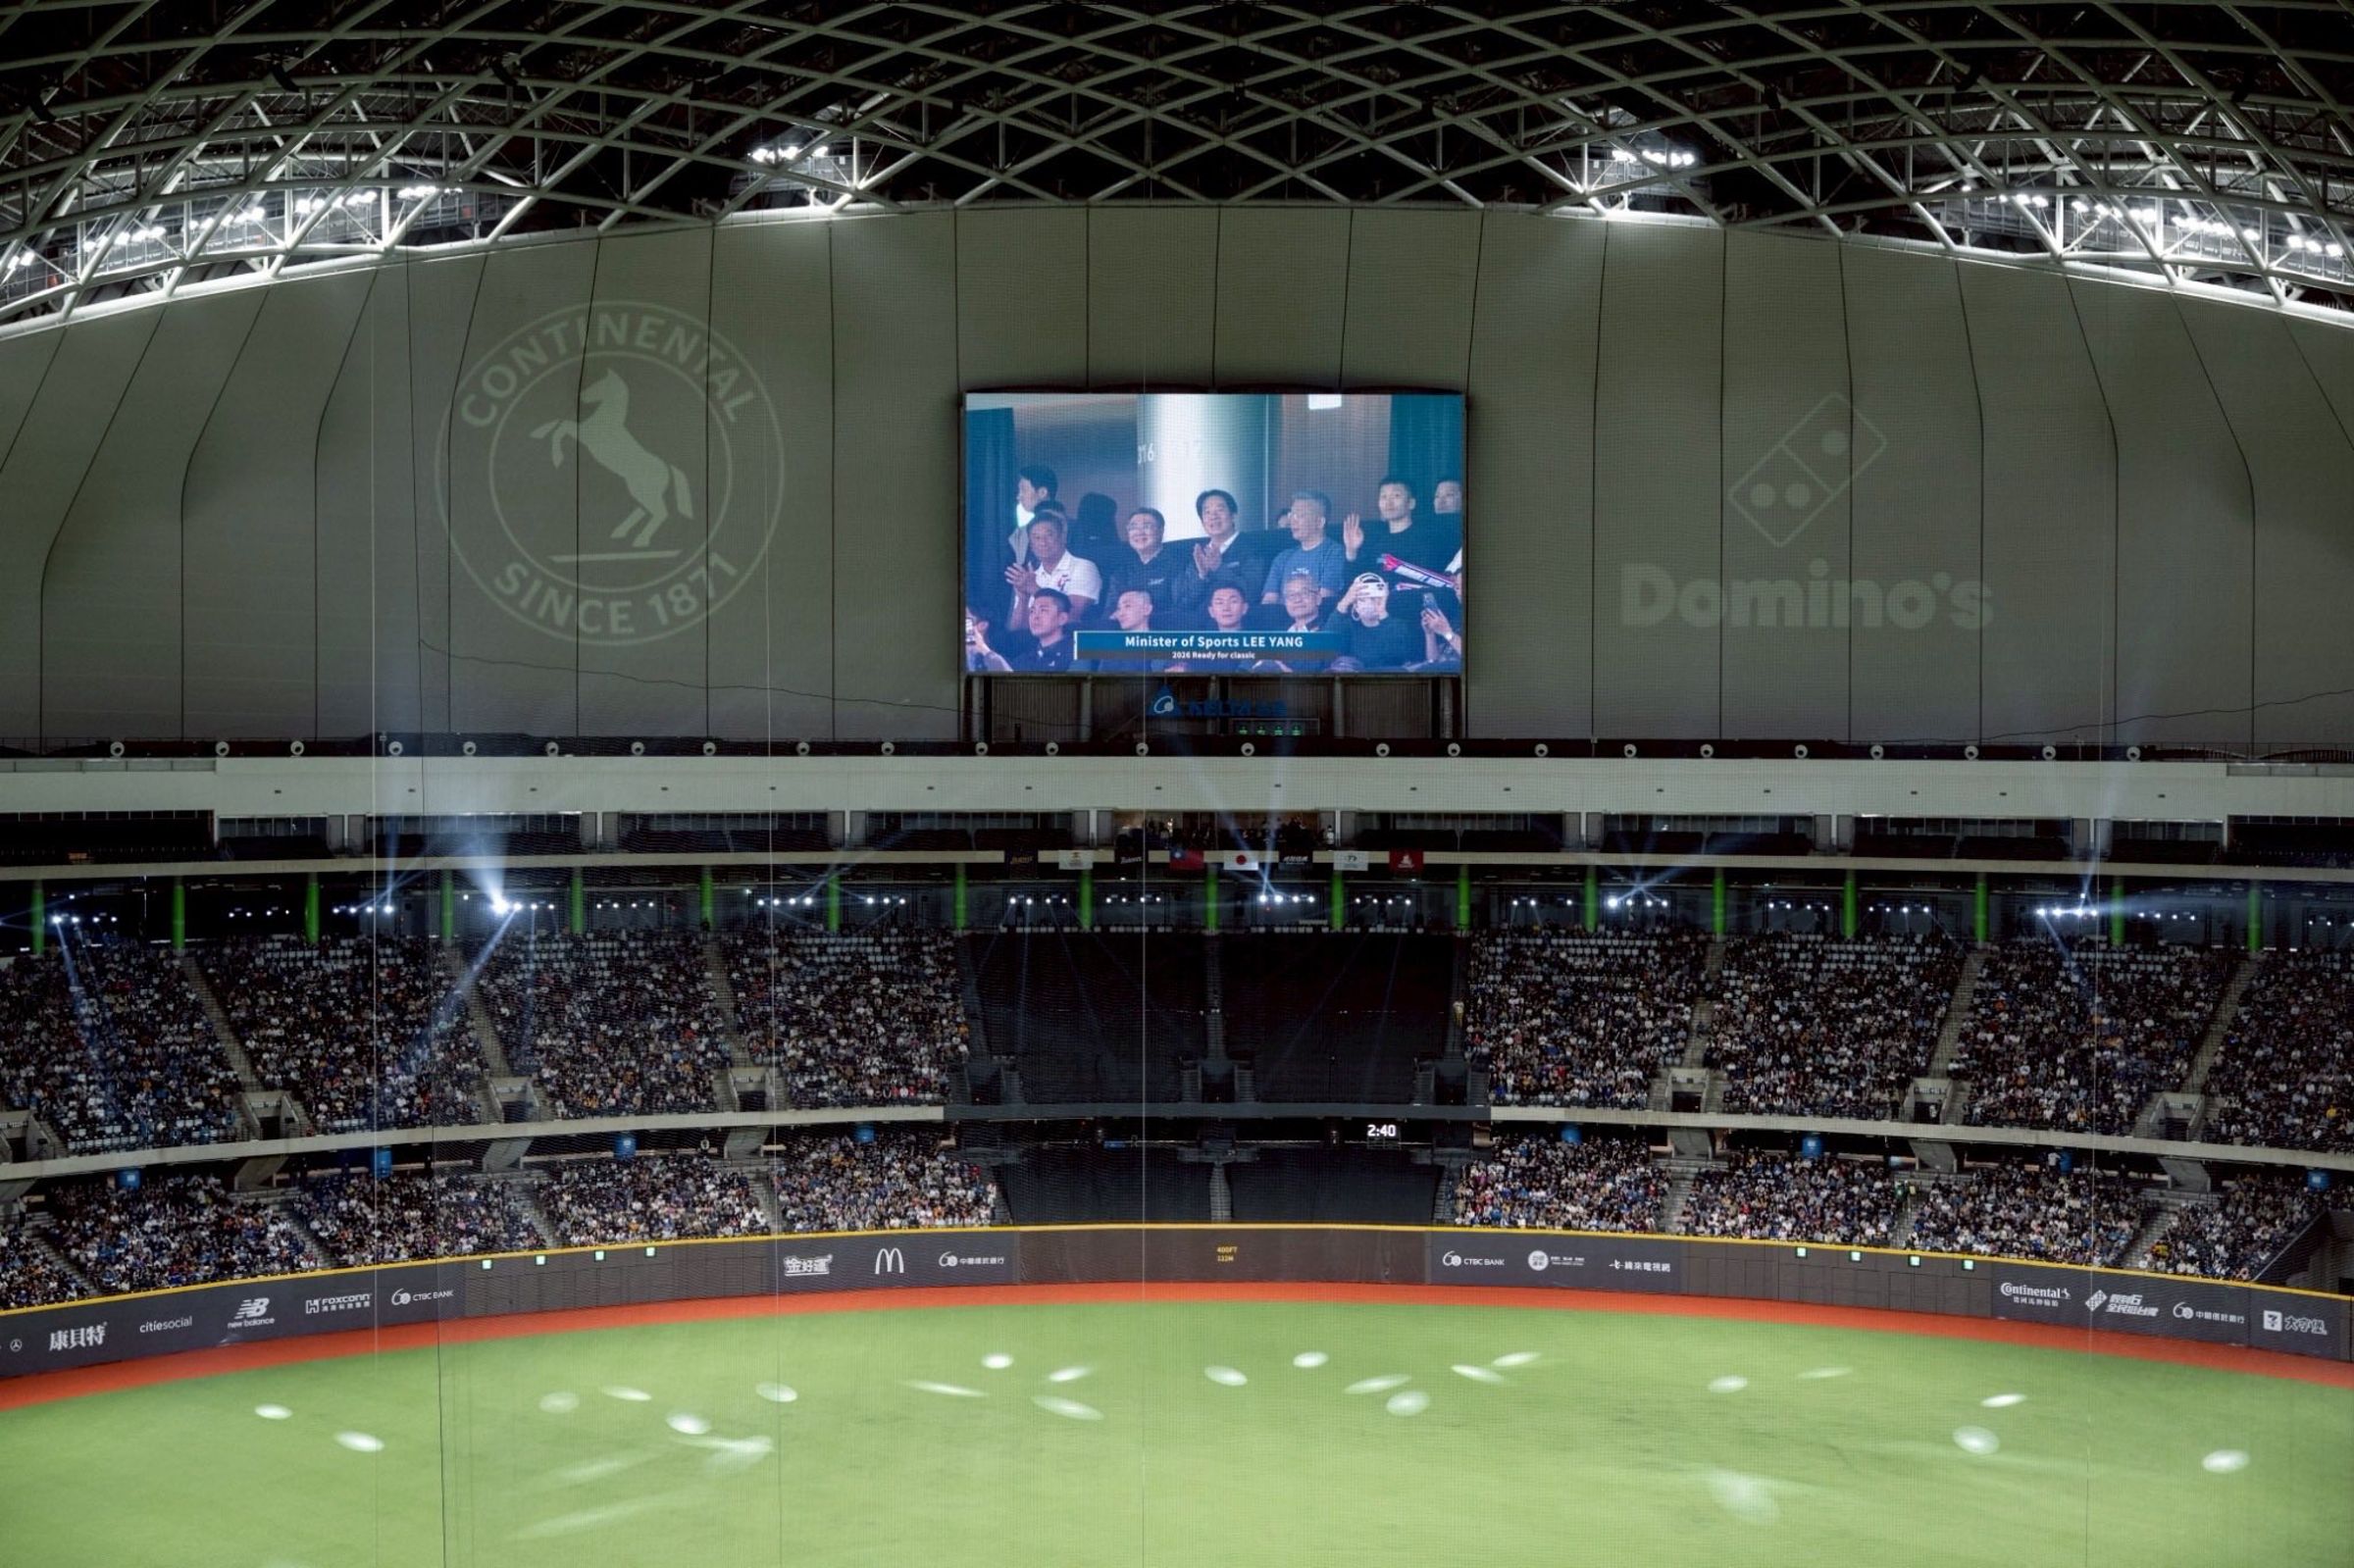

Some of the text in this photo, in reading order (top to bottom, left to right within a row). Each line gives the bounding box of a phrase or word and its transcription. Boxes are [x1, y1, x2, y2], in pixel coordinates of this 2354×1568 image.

[460, 312, 755, 429] CONTINENTAL
[493, 551, 739, 634] SINCE 1871
[1620, 557, 1995, 630] Domino's
[1125, 635, 1304, 649] Minister of Sports LEE YANG
[1193, 651, 1215, 660] Ready
[1366, 1124, 1397, 1137] 2:40
[413, 1290, 454, 1301] CTBC BANK
[2000, 1282, 2061, 1299] Continental
[139, 1316, 193, 1334] citiesocial
[49, 1324, 107, 1351] 康貝特
